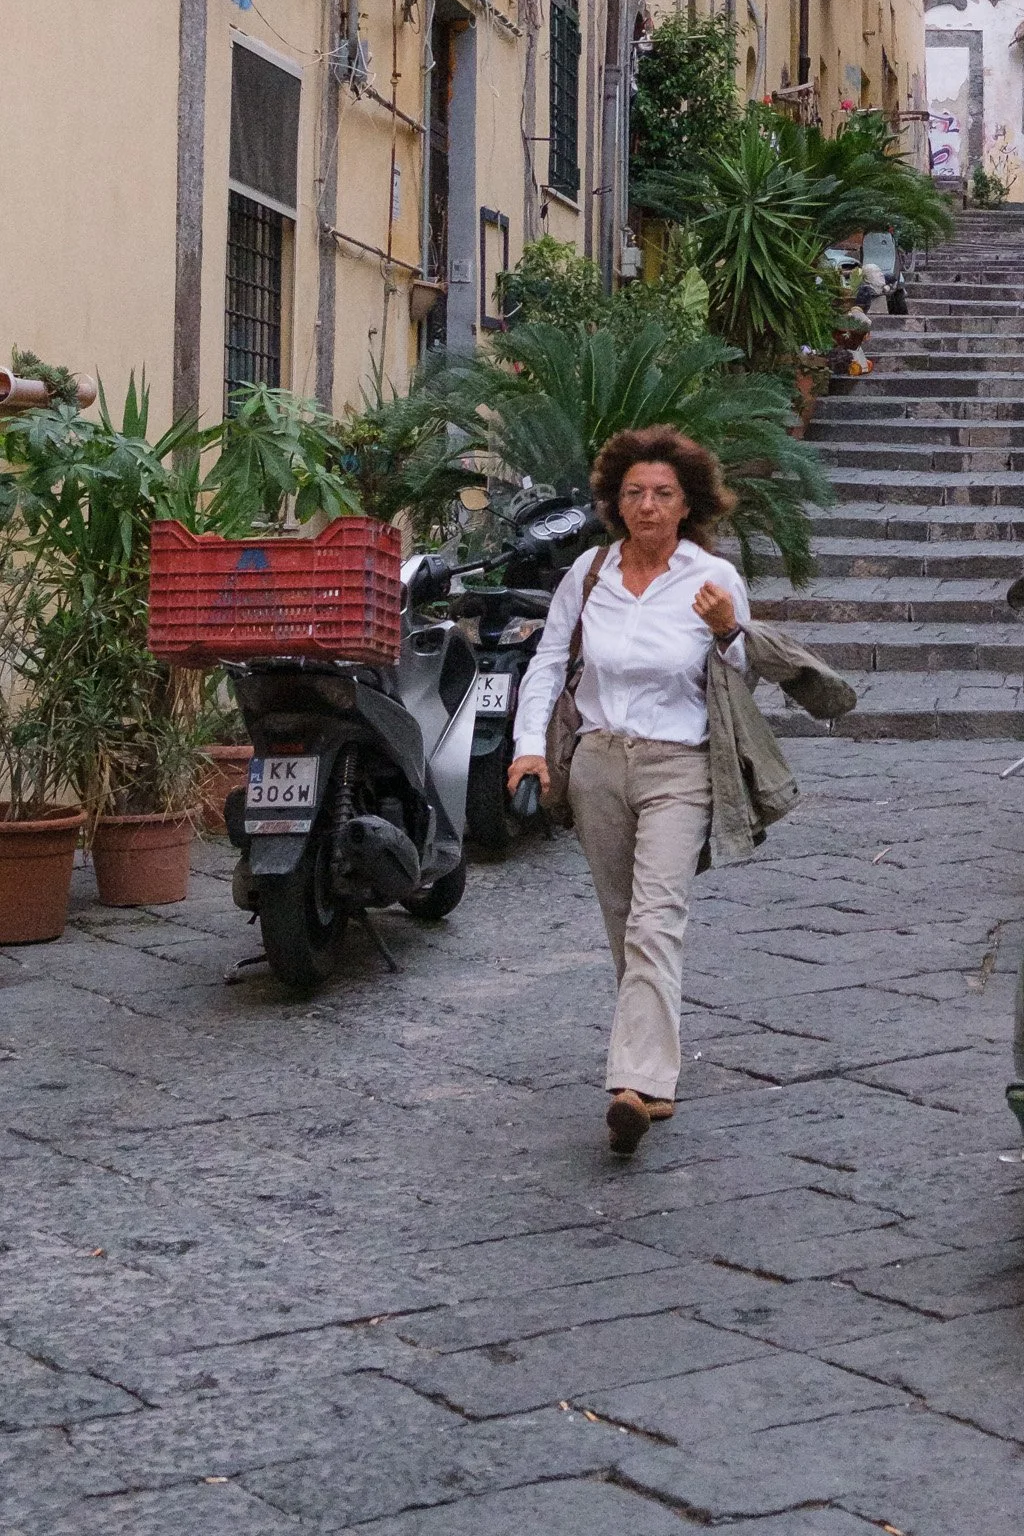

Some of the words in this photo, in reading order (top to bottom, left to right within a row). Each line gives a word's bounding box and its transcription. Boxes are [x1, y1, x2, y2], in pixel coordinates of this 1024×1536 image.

[476, 694, 503, 708] 5X
[250, 772, 262, 782] PL
[270, 761, 298, 780] KK
[252, 784, 310, 803] 306W
